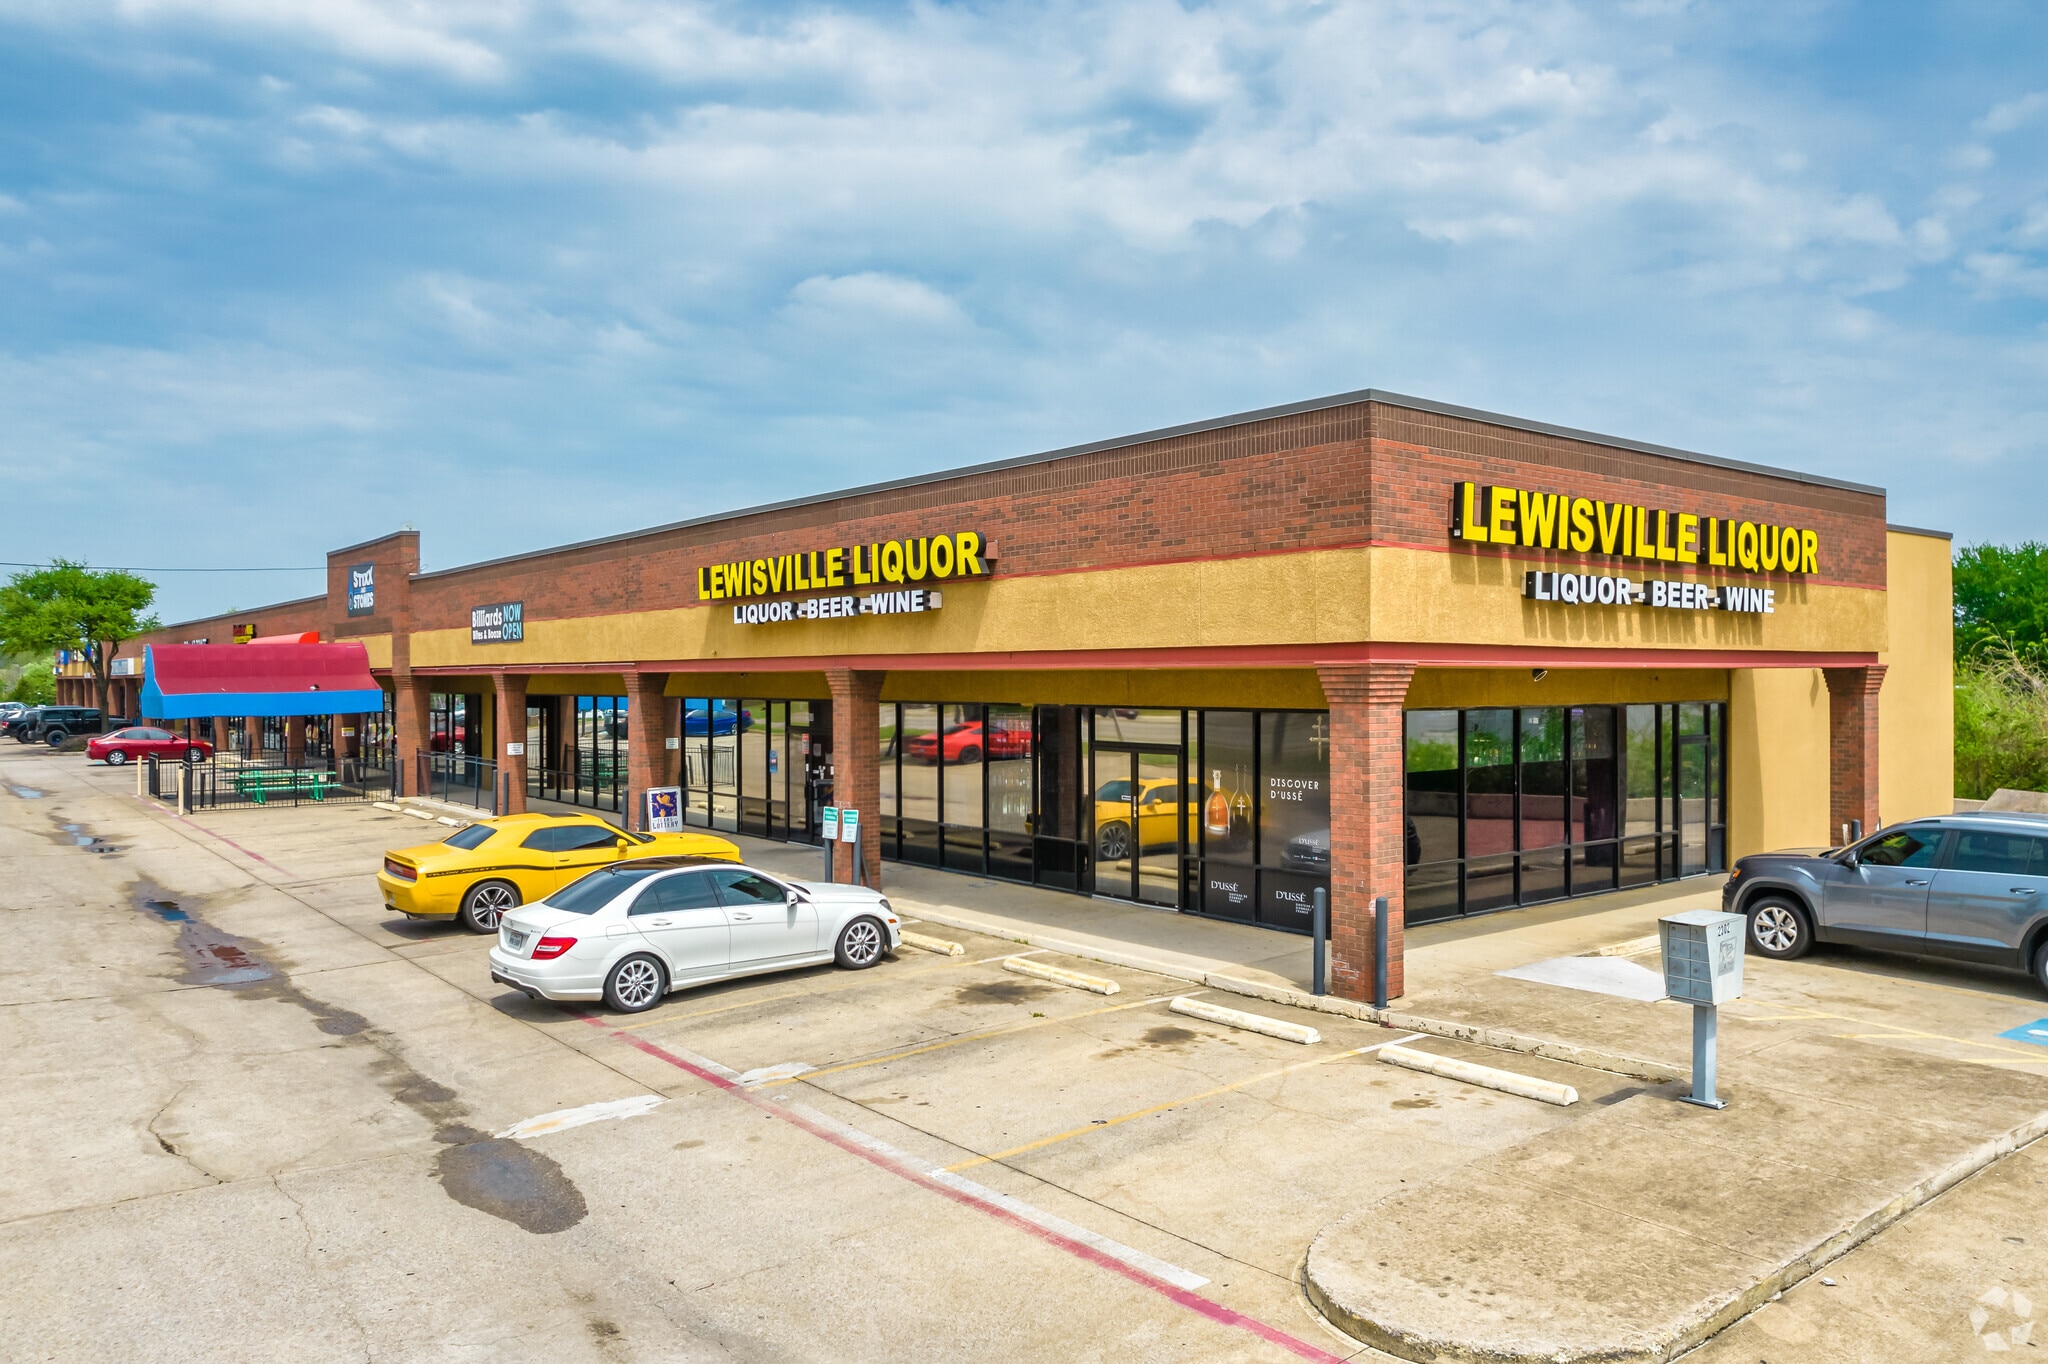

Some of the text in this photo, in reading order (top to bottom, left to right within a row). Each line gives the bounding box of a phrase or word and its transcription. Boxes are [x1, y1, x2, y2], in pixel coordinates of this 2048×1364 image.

[1463, 481, 1820, 575] LEWISVILLE LIQUOR
[353, 565, 374, 588] STIXX
[698, 531, 983, 601] LEWISVILLE LIQUOR
[1534, 570, 1776, 614] LIQUOR BEER WINE
[503, 603, 522, 622] NOW
[733, 589, 925, 625] LIQUOR BEER WINE
[472, 608, 503, 628] Billiards
[502, 621, 522, 640] OPEN
[1270, 777, 1319, 790] DISCOVER
[653, 820, 679, 829] LOTTERY
